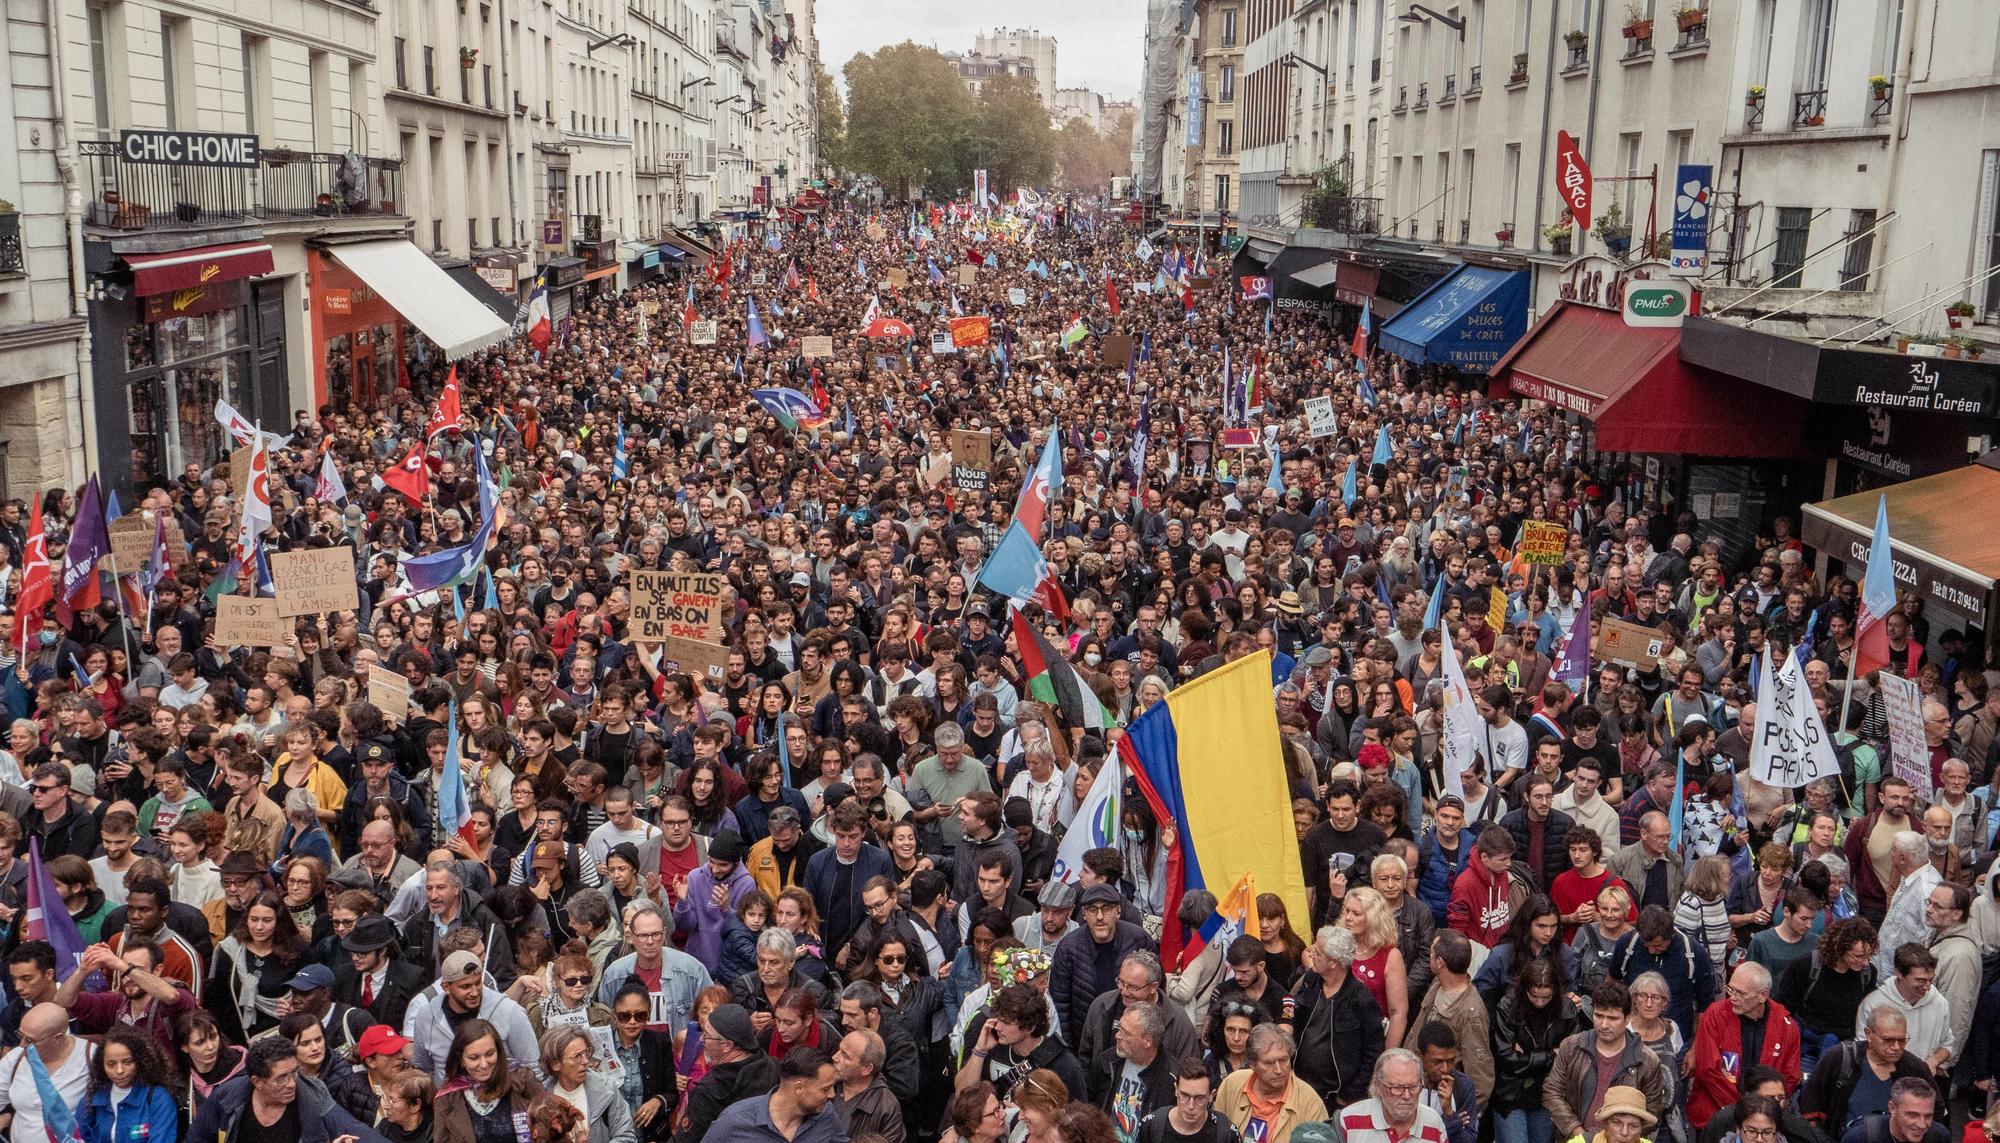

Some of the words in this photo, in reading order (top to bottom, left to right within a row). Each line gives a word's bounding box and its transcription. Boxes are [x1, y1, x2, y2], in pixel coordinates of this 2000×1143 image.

[1190, 72, 1199, 135] HOTEL
[126, 134, 182, 161] CHIC
[187, 136, 256, 163] HOME
[665, 151, 690, 159] PIZZA
[1563, 151, 1586, 209] TABAC
[1672, 256, 1705, 269] LOTO
[1277, 297, 1319, 310] ESPACE
[1479, 303, 1496, 313] LES
[1634, 299, 1662, 309] PMU
[1461, 330, 1472, 340] DE
[1449, 351, 1498, 361] TRAITEUR
[1908, 360, 1939, 391] 진미
[1557, 389, 1566, 405] DE
[1855, 385, 1931, 409] Restaurant
[1933, 392, 1981, 413] Coréen
[1843, 439, 1882, 467] Restaurant
[1883, 453, 1911, 476] Coréen
[955, 466, 987, 480] Nous
[957, 478, 984, 489] tous
[289, 552, 326, 566] MANU
[275, 563, 321, 579] ESSENCE
[324, 560, 348, 574] GAZ
[636, 575, 653, 592] EN
[657, 576, 690, 592] HAUT
[694, 577, 720, 595] ILS
[297, 590, 316, 599] OUI
[648, 589, 667, 606] SE
[672, 592, 719, 608] GAVENT
[230, 604, 242, 616] ON
[245, 604, 264, 616] EST
[301, 597, 340, 610] AMISH
[634, 605, 651, 620] EN
[657, 606, 682, 622] BAS
[685, 608, 708, 625] ON
[643, 620, 663, 637] EN
[670, 623, 710, 639] BAVE
